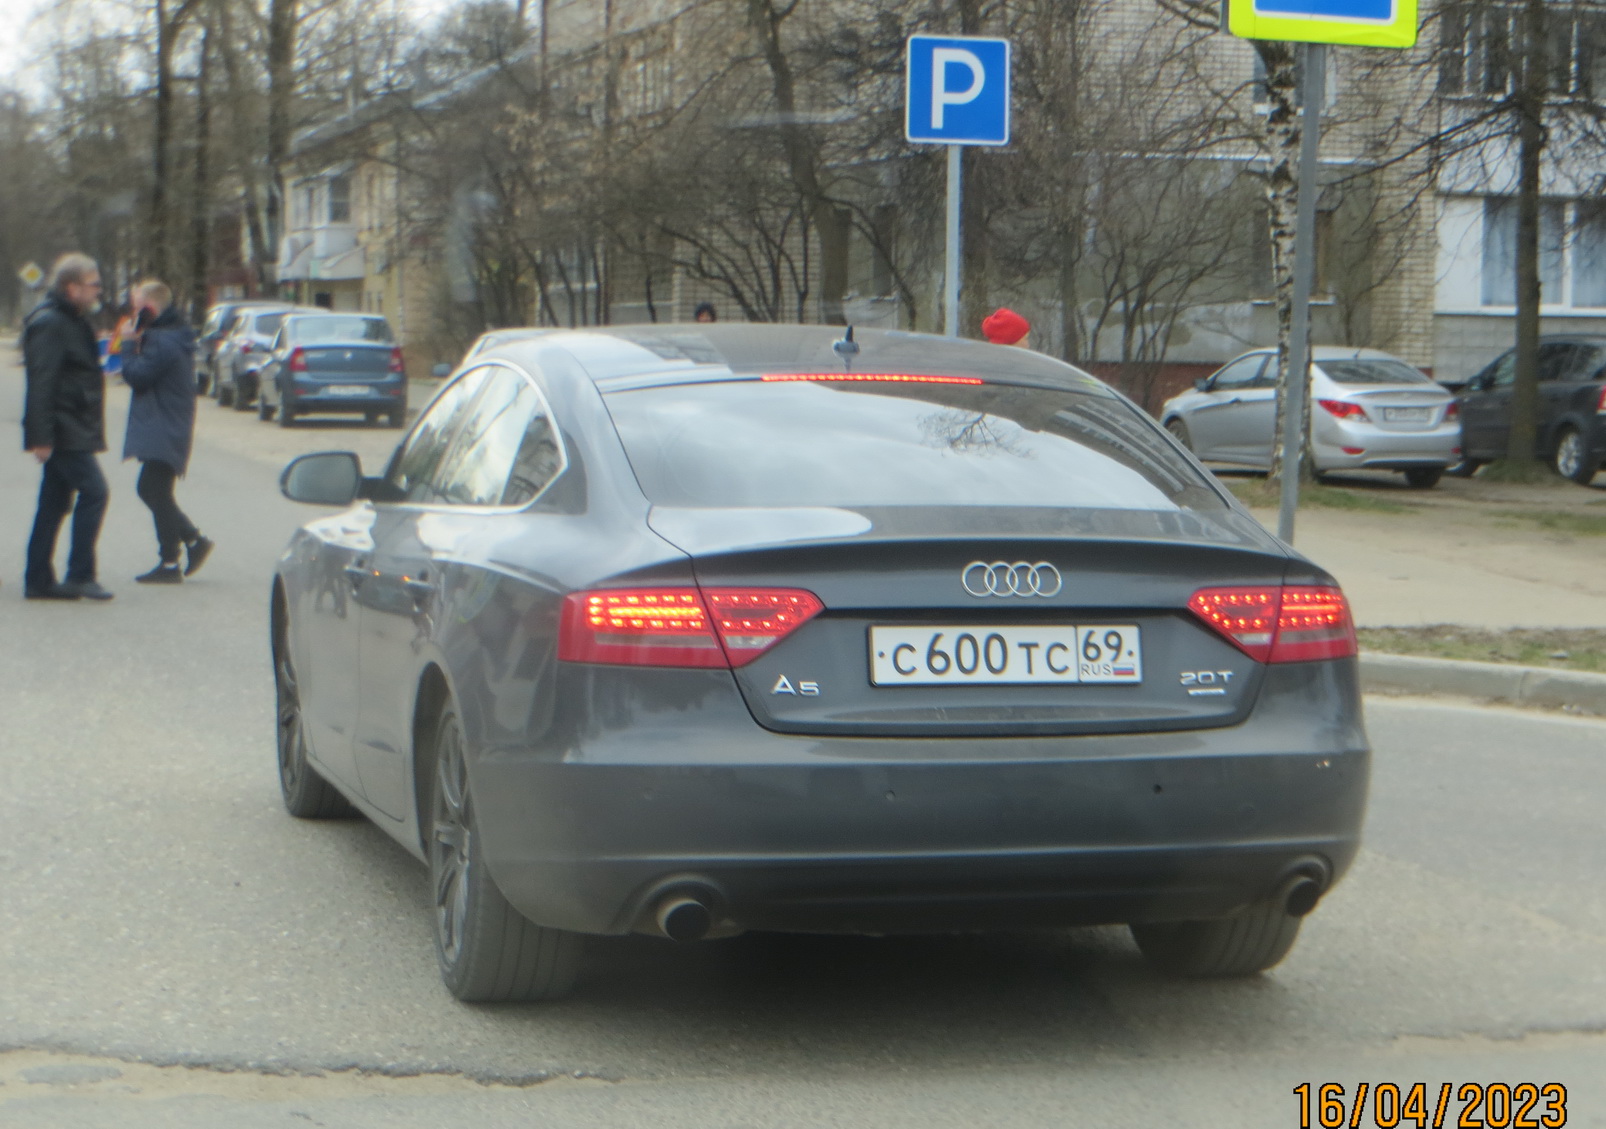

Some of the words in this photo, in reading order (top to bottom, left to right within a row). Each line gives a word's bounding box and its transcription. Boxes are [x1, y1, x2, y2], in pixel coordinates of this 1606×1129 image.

[931, 47, 985, 129] P
[1081, 629, 1123, 662] 69
[1080, 663, 1112, 676] RUS
[770, 673, 820, 696] A5
